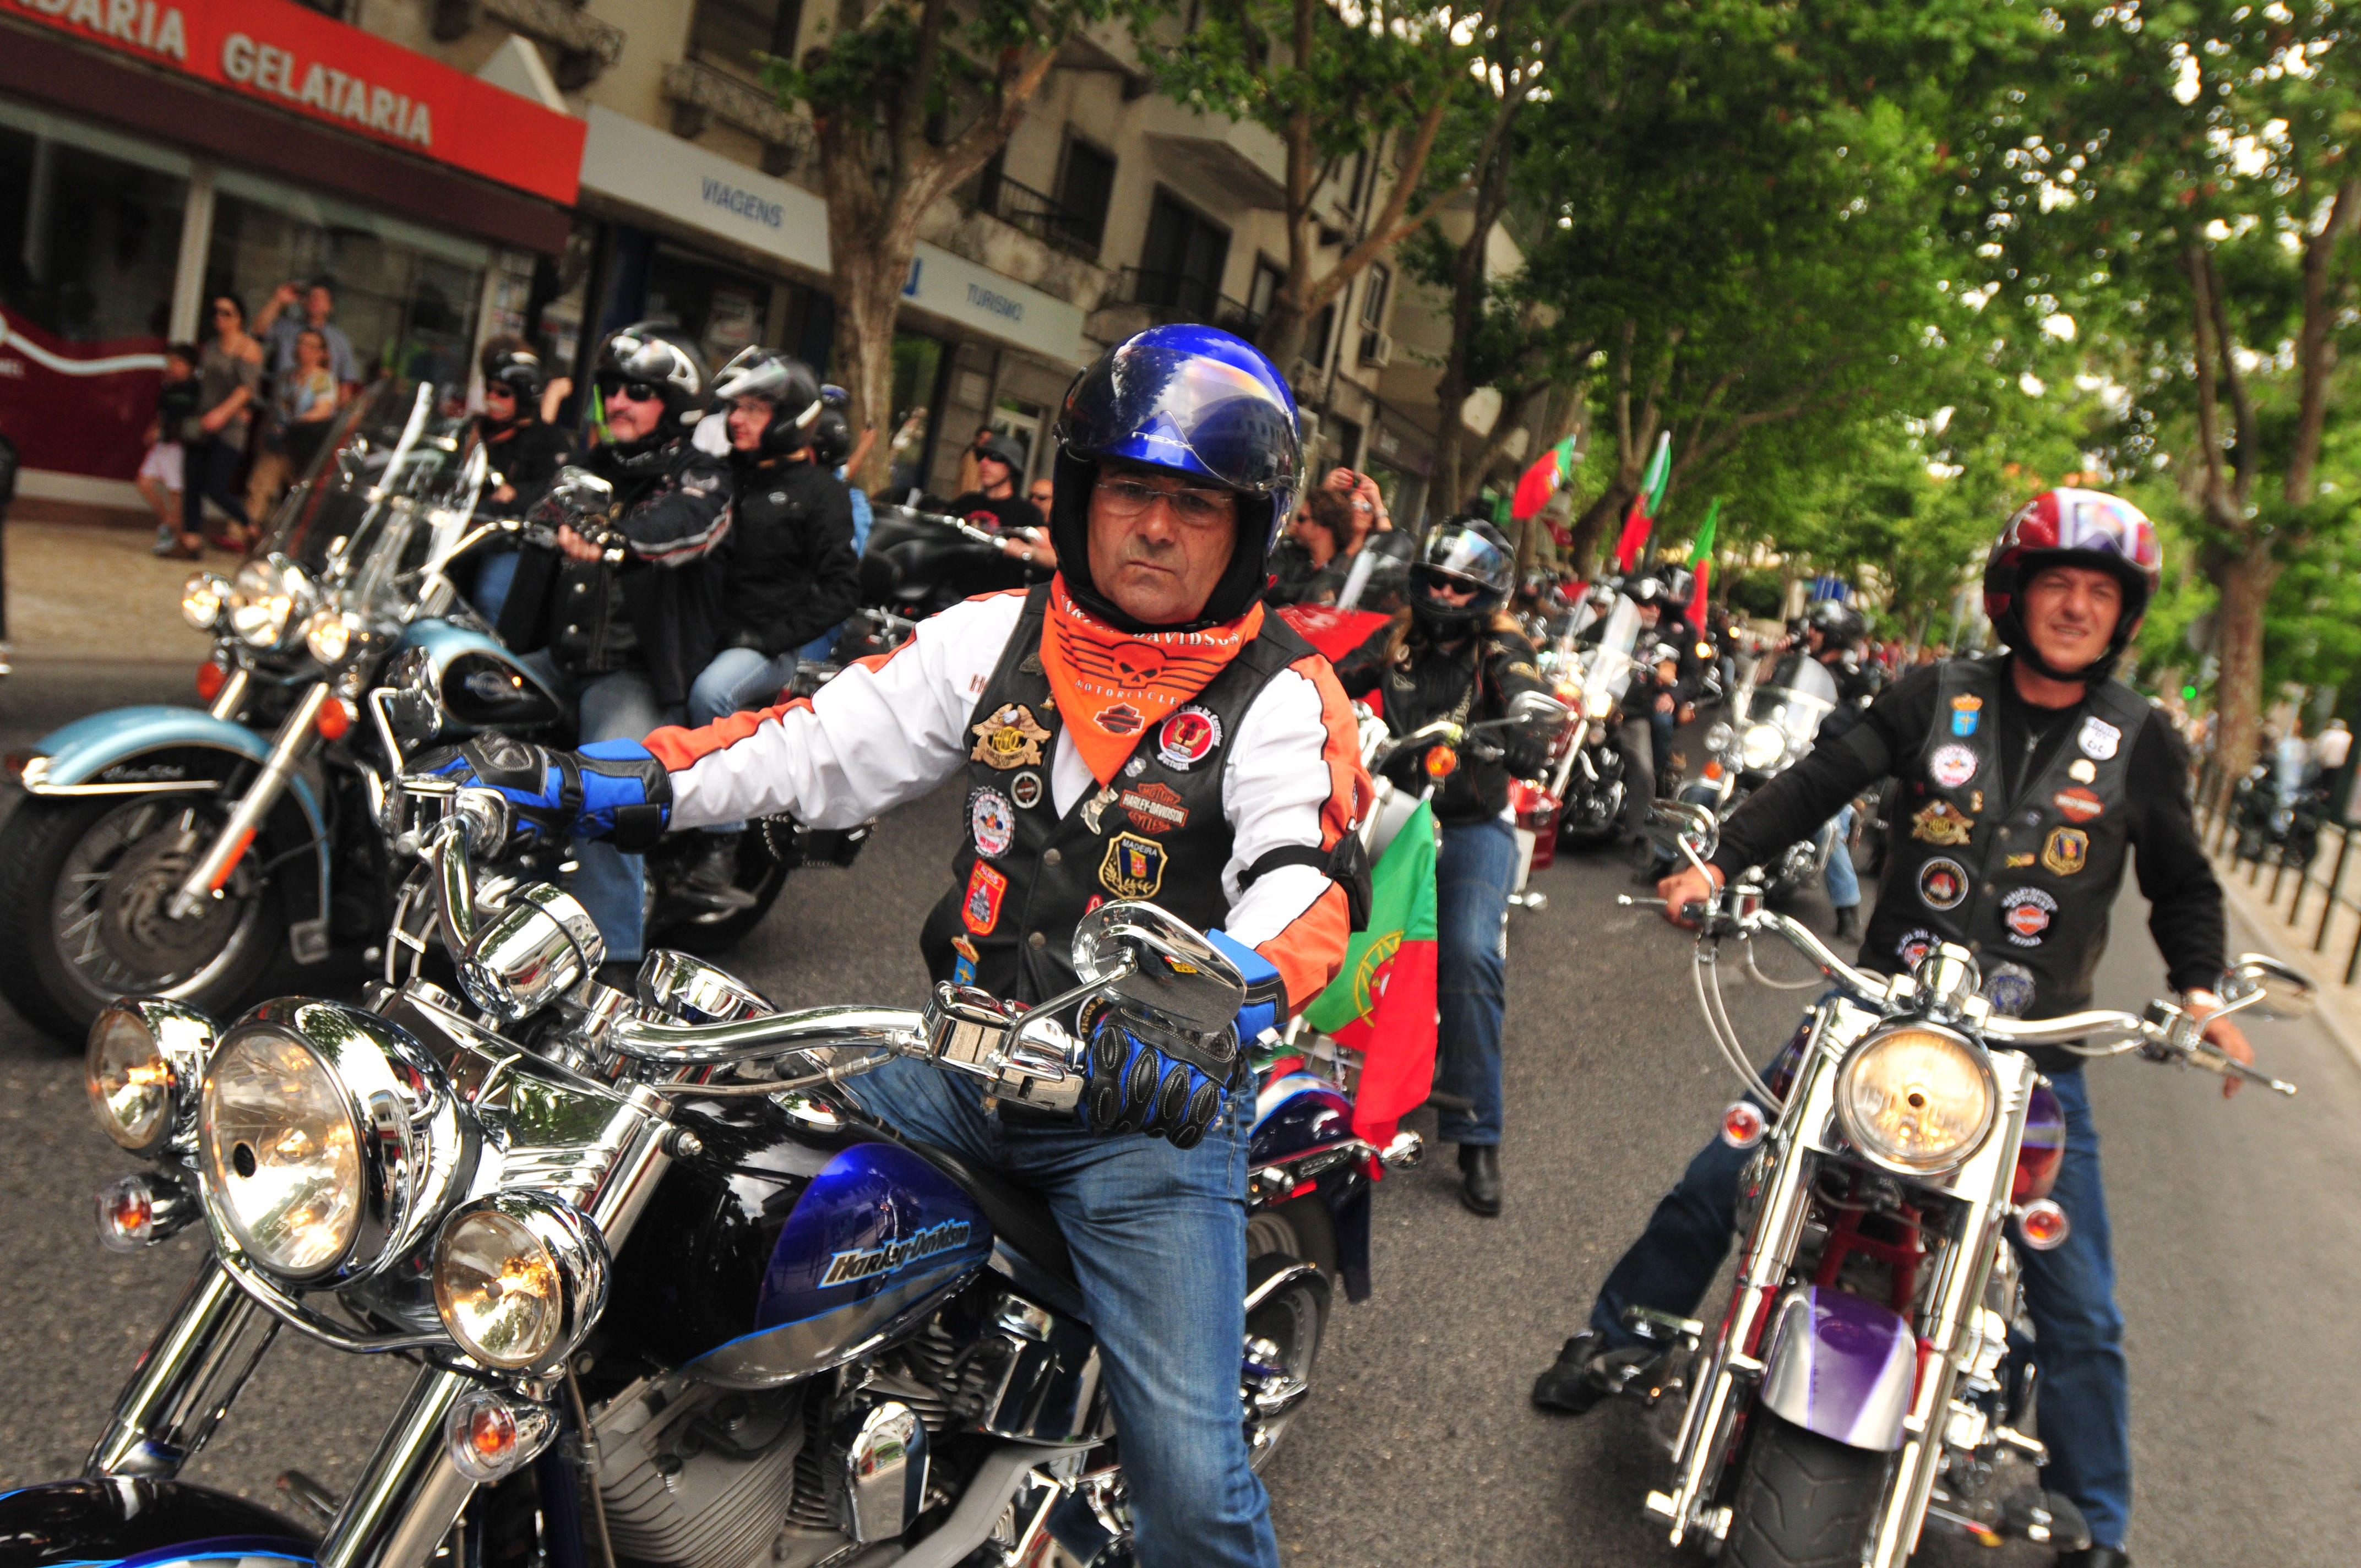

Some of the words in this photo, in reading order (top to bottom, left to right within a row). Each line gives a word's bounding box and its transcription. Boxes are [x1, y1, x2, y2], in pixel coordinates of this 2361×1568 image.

[18, 0, 188, 60] ARIA
[221, 33, 432, 146] GELATARIA
[701, 176, 784, 228] VIAGENS
[966, 282, 1025, 321] TURISMO
[1122, 793, 1185, 824] HARLEY-DAVIDSON
[1122, 838, 1157, 857] MADEIRA
[980, 865, 999, 885] PARIS
[1081, 1003, 1096, 1033] PICOS
[820, 1220, 969, 1287] Harley-Davidson
